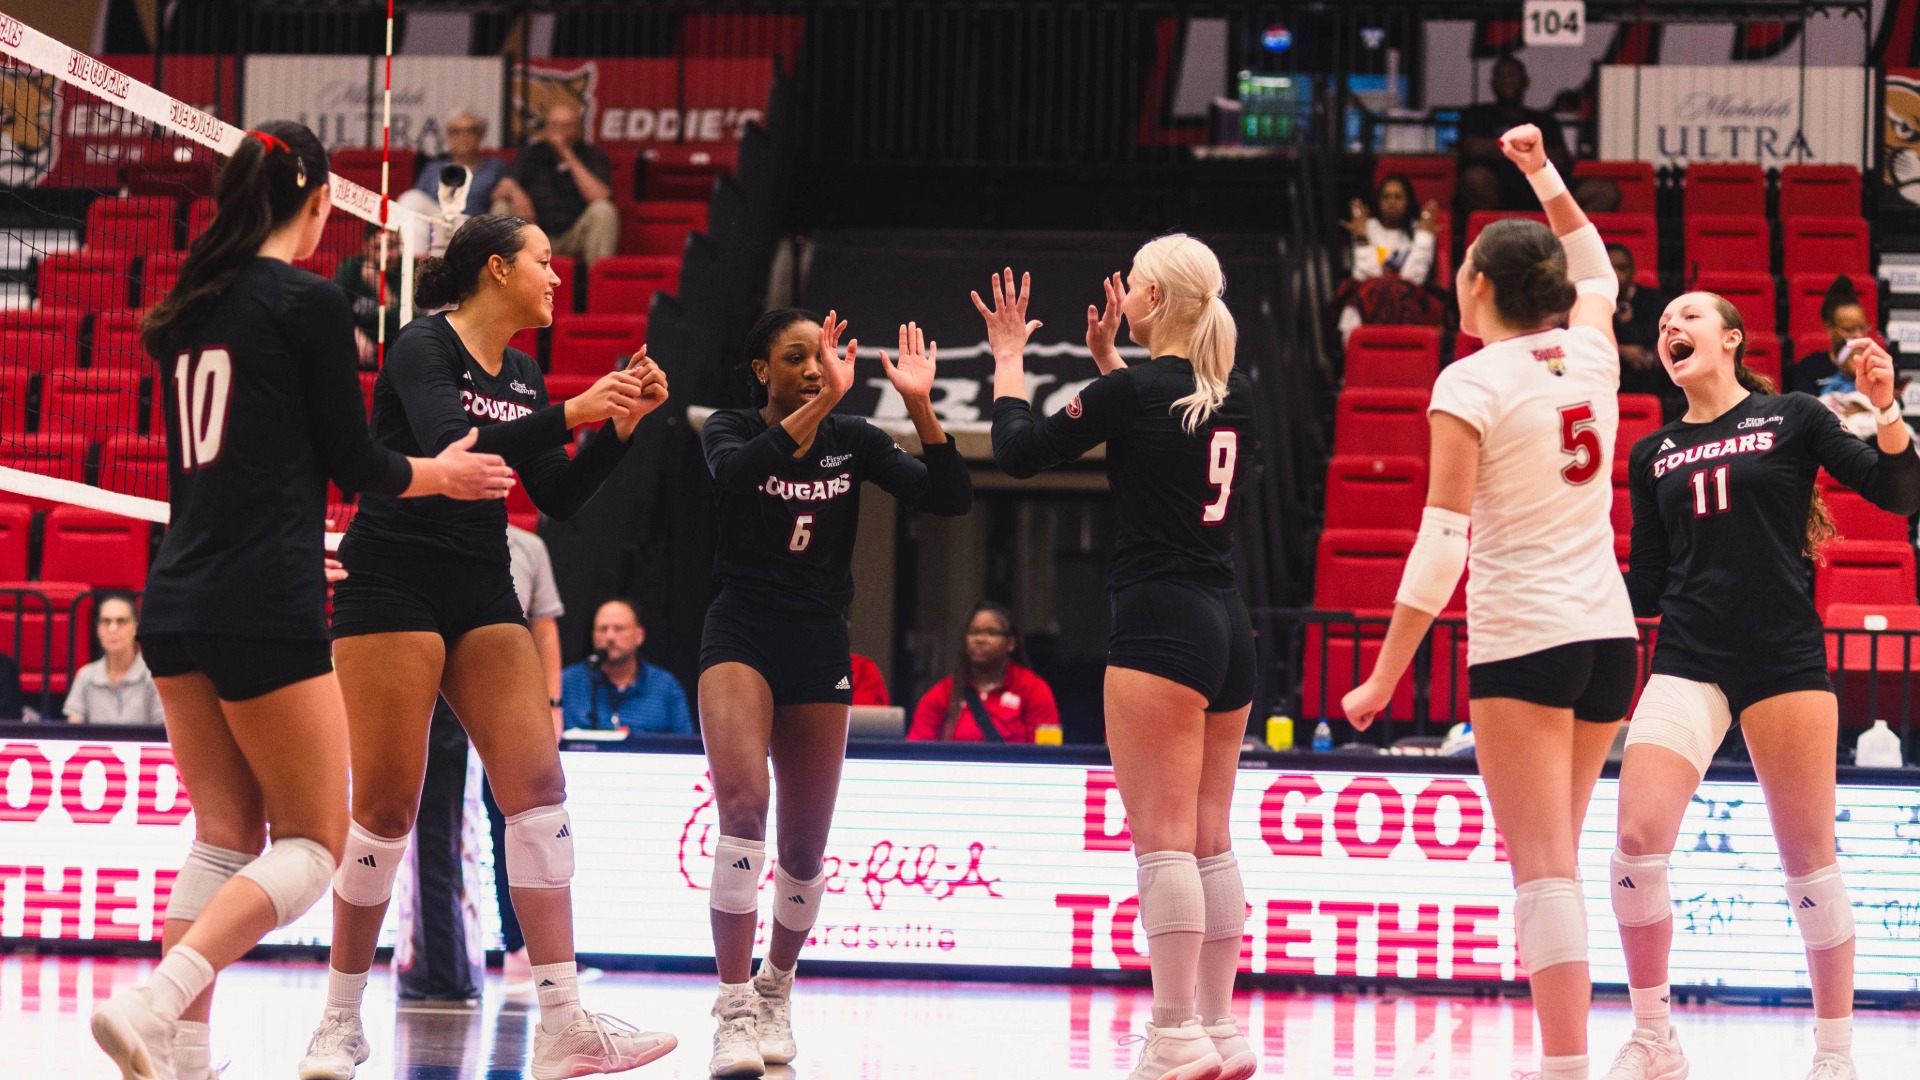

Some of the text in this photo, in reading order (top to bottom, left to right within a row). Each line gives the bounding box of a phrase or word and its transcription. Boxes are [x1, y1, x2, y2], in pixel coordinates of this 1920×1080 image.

[1530, 10, 1579, 35] 104
[90, 61, 130, 99] COUGARS
[1657, 124, 1814, 158] ULTRA
[174, 347, 232, 471] 10
[459, 389, 534, 422] COUGAR
[1737, 415, 1785, 430] Commnity
[1556, 401, 1604, 486] 5
[1653, 431, 1776, 479] COUGARS
[758, 473, 850, 501] OUGARS
[1203, 428, 1238, 524] 9
[1691, 465, 1730, 516] 11
[788, 513, 814, 552] 6
[0, 744, 193, 825] OOD
[1260, 774, 1512, 862] GOO
[1055, 893, 1530, 981] TETHE
